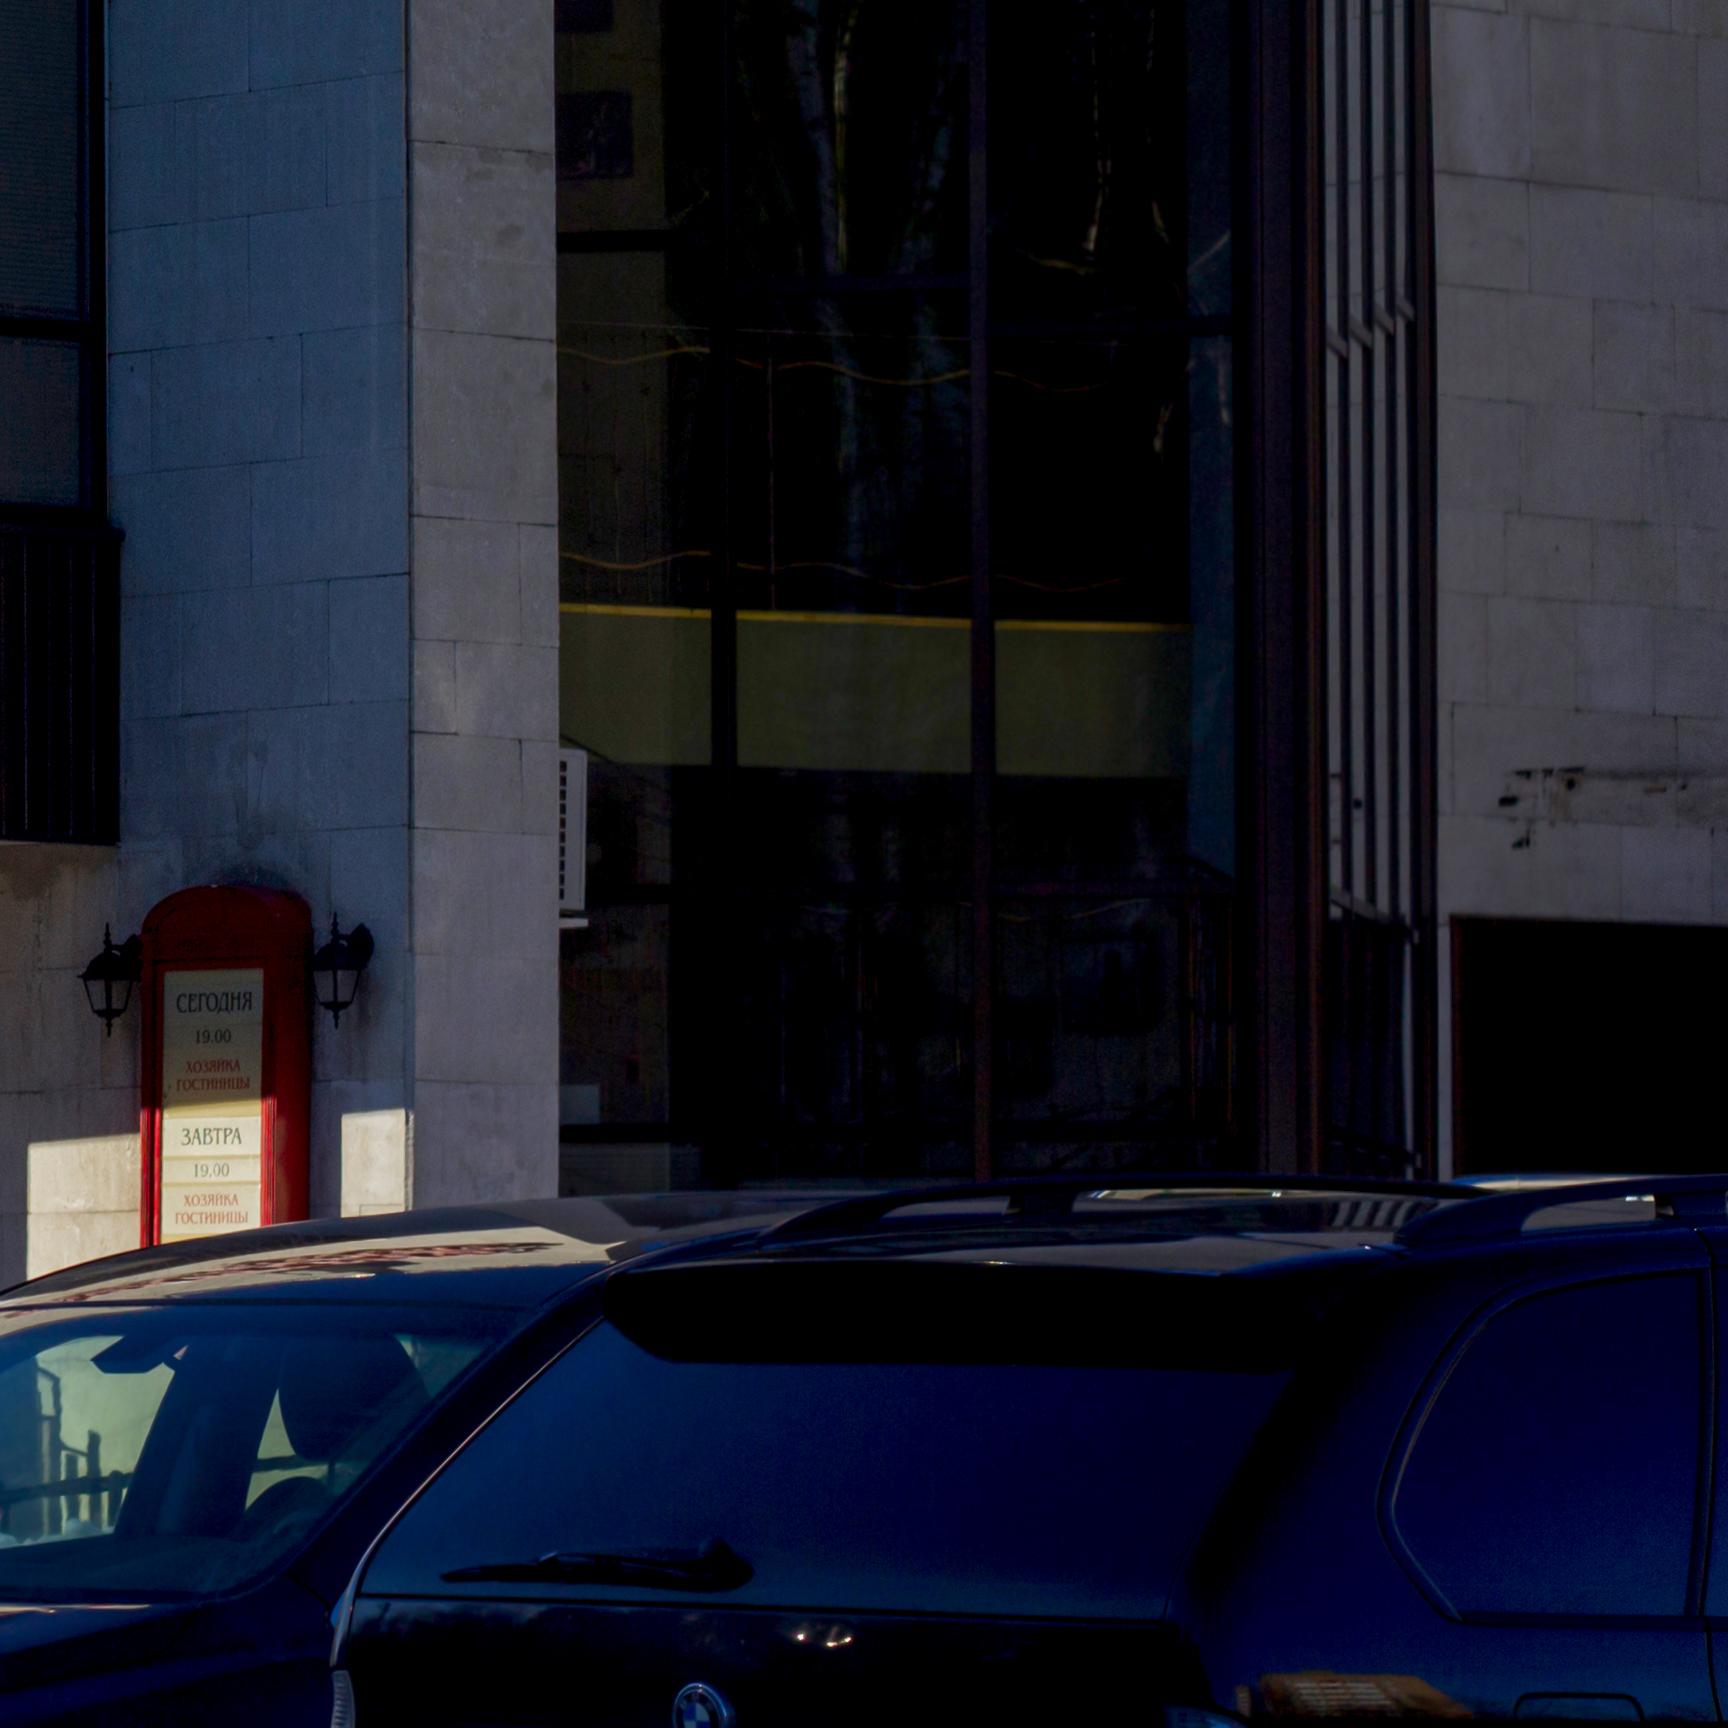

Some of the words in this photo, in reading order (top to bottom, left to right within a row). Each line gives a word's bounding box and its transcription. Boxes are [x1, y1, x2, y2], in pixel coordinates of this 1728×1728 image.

[176, 991, 253, 1015] СЕГОДНЯ
[195, 1028, 232, 1045] 19.00
[186, 1057, 241, 1074] ХОЗЯЙКА
[176, 1076, 250, 1092] ГОСТИНИЦЫ
[181, 1127, 242, 1147] ЗАВТРА
[184, 1192, 239, 1207] ХОЗЯЙКА
[175, 1211, 249, 1225] ГОСТИНИЦЫ
